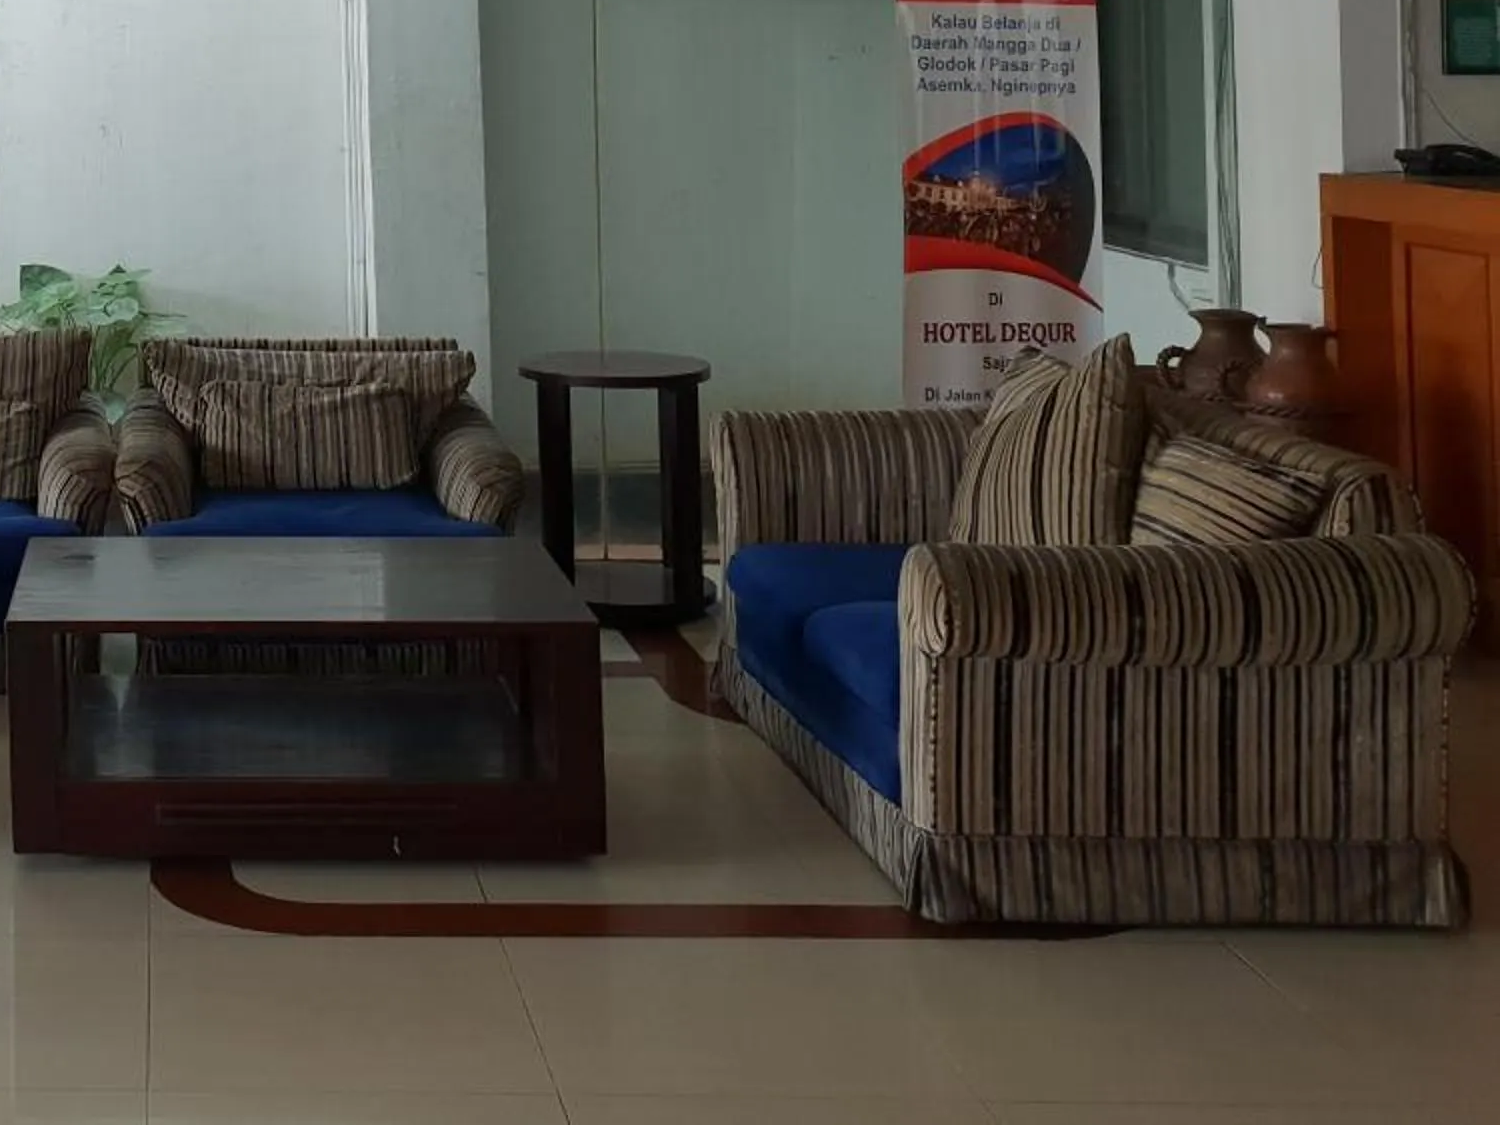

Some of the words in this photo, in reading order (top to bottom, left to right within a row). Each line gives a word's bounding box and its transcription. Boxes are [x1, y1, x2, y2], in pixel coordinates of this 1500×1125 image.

[931, 13, 977, 30] Kalau
[911, 35, 968, 51] Daerah
[973, 36, 1036, 55] Mangga
[1041, 37, 1070, 51] Dua
[917, 56, 975, 72] Glodok
[989, 58, 1035, 72] Pasar
[1041, 59, 1075, 77] Pagi
[988, 293, 1003, 306] Di
[923, 322, 997, 344] HOTEL
[1000, 322, 1077, 347] DEQUR
[925, 388, 940, 402] Di
[944, 389, 981, 402] Jalan
